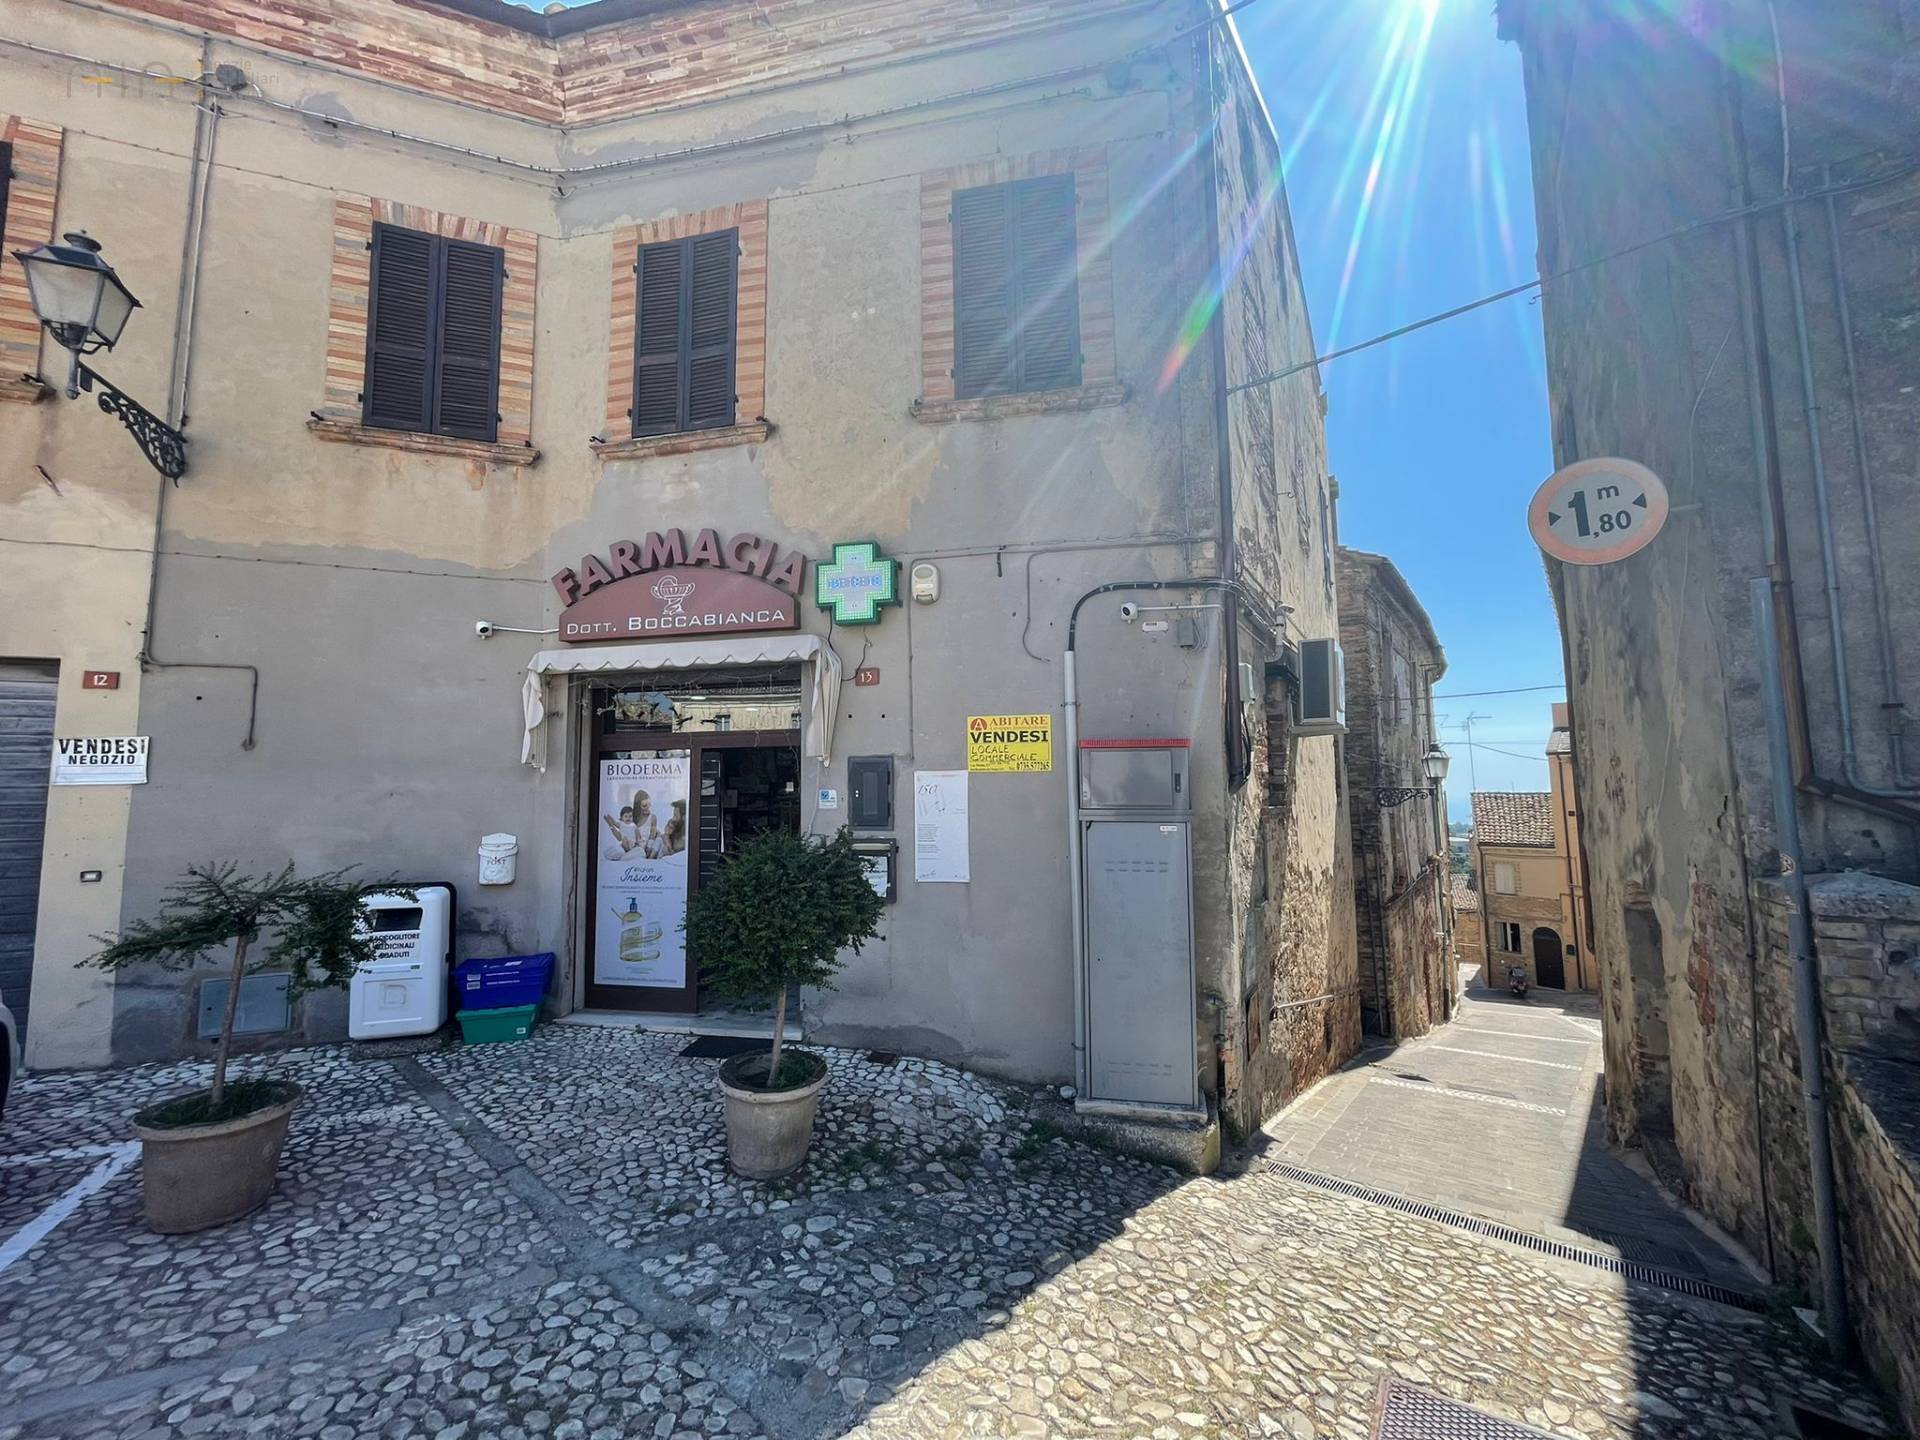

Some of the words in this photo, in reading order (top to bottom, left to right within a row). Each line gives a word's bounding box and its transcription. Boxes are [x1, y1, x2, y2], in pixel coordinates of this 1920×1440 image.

[1597, 485, 1619, 500] m
[551, 528, 807, 607] FARMACIA
[93, 674, 108, 686] 12
[861, 671, 873, 683] 13
[990, 715, 1048, 727] ABITARE
[970, 730, 1049, 744] VENDESI
[59, 738, 145, 755] VENDESI
[971, 744, 1009, 755] LOCALE
[68, 754, 136, 765] NEGOZIO
[607, 763, 683, 776] BIODERMA
